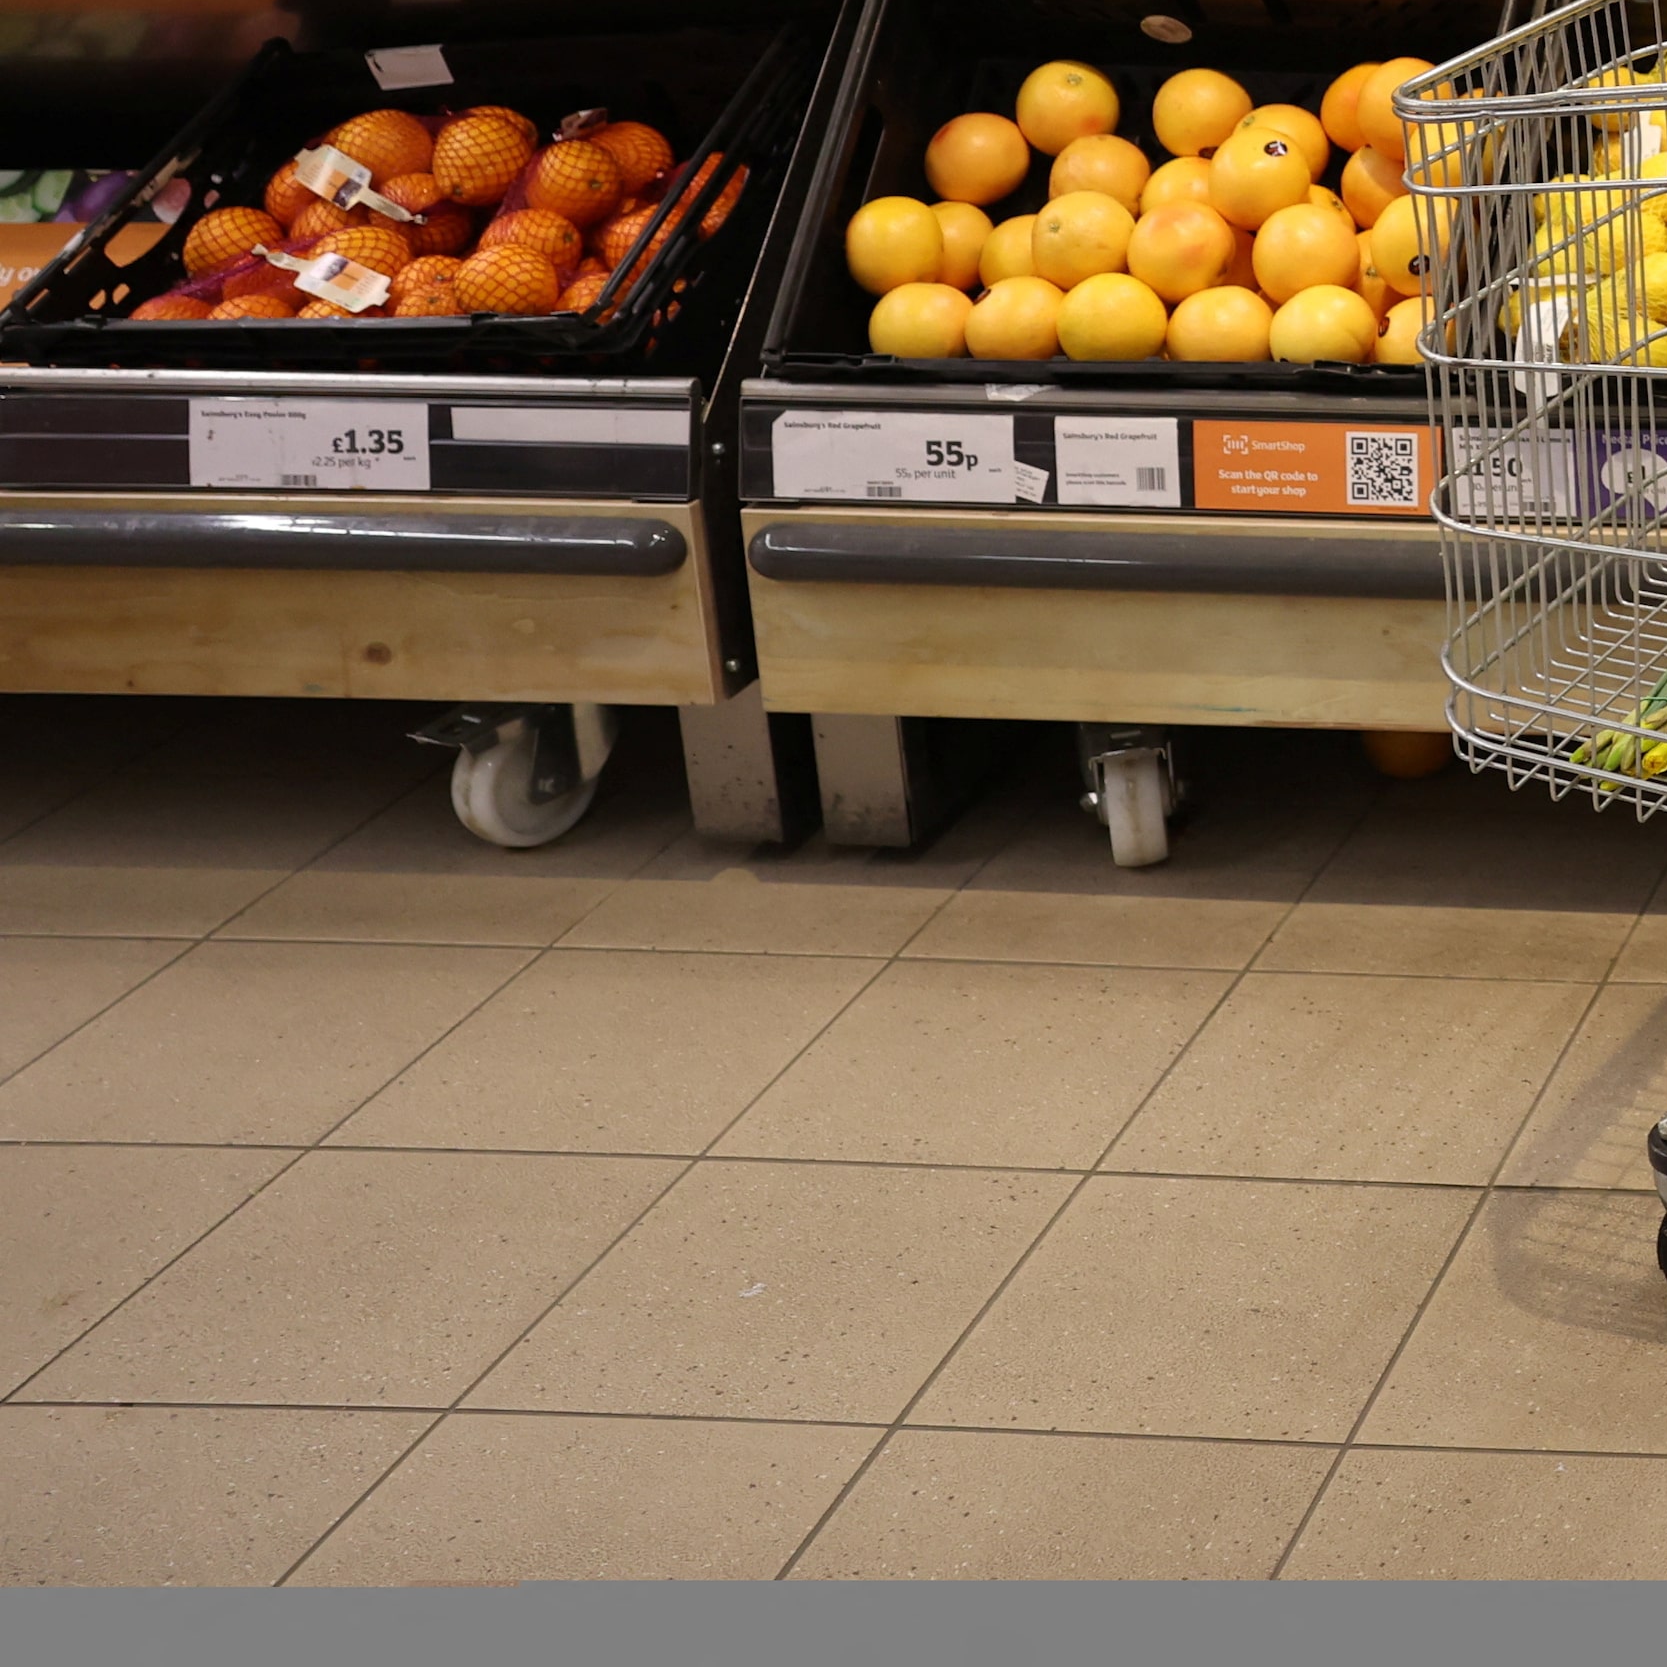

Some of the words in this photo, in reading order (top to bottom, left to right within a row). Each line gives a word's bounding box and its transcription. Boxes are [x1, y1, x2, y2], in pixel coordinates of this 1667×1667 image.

[784, 421, 826, 431] Sainsbury's
[827, 421, 842, 431] Red
[843, 421, 881, 431] Grapefruit
[333, 429, 404, 455] £1.35
[1063, 433, 1103, 442] Sainsbury's
[1104, 433, 1119, 442] Red
[1120, 433, 1158, 442] Grapefruit
[1251, 439, 1305, 453] SmartShop
[925, 439, 979, 471] 55p
[338, 460, 357, 469] per
[358, 458, 371, 469] kg
[914, 471, 932, 481] per
[934, 468, 956, 479] unit
[1218, 469, 1243, 480] Scan
[1245, 469, 1262, 481] the
[1263, 470, 1279, 482] QR
[1281, 470, 1305, 482] code
[1306, 471, 1318, 482] to
[1231, 485, 1256, 495] start
[1255, 487, 1280, 497] your
[1281, 486, 1306, 498] shop
